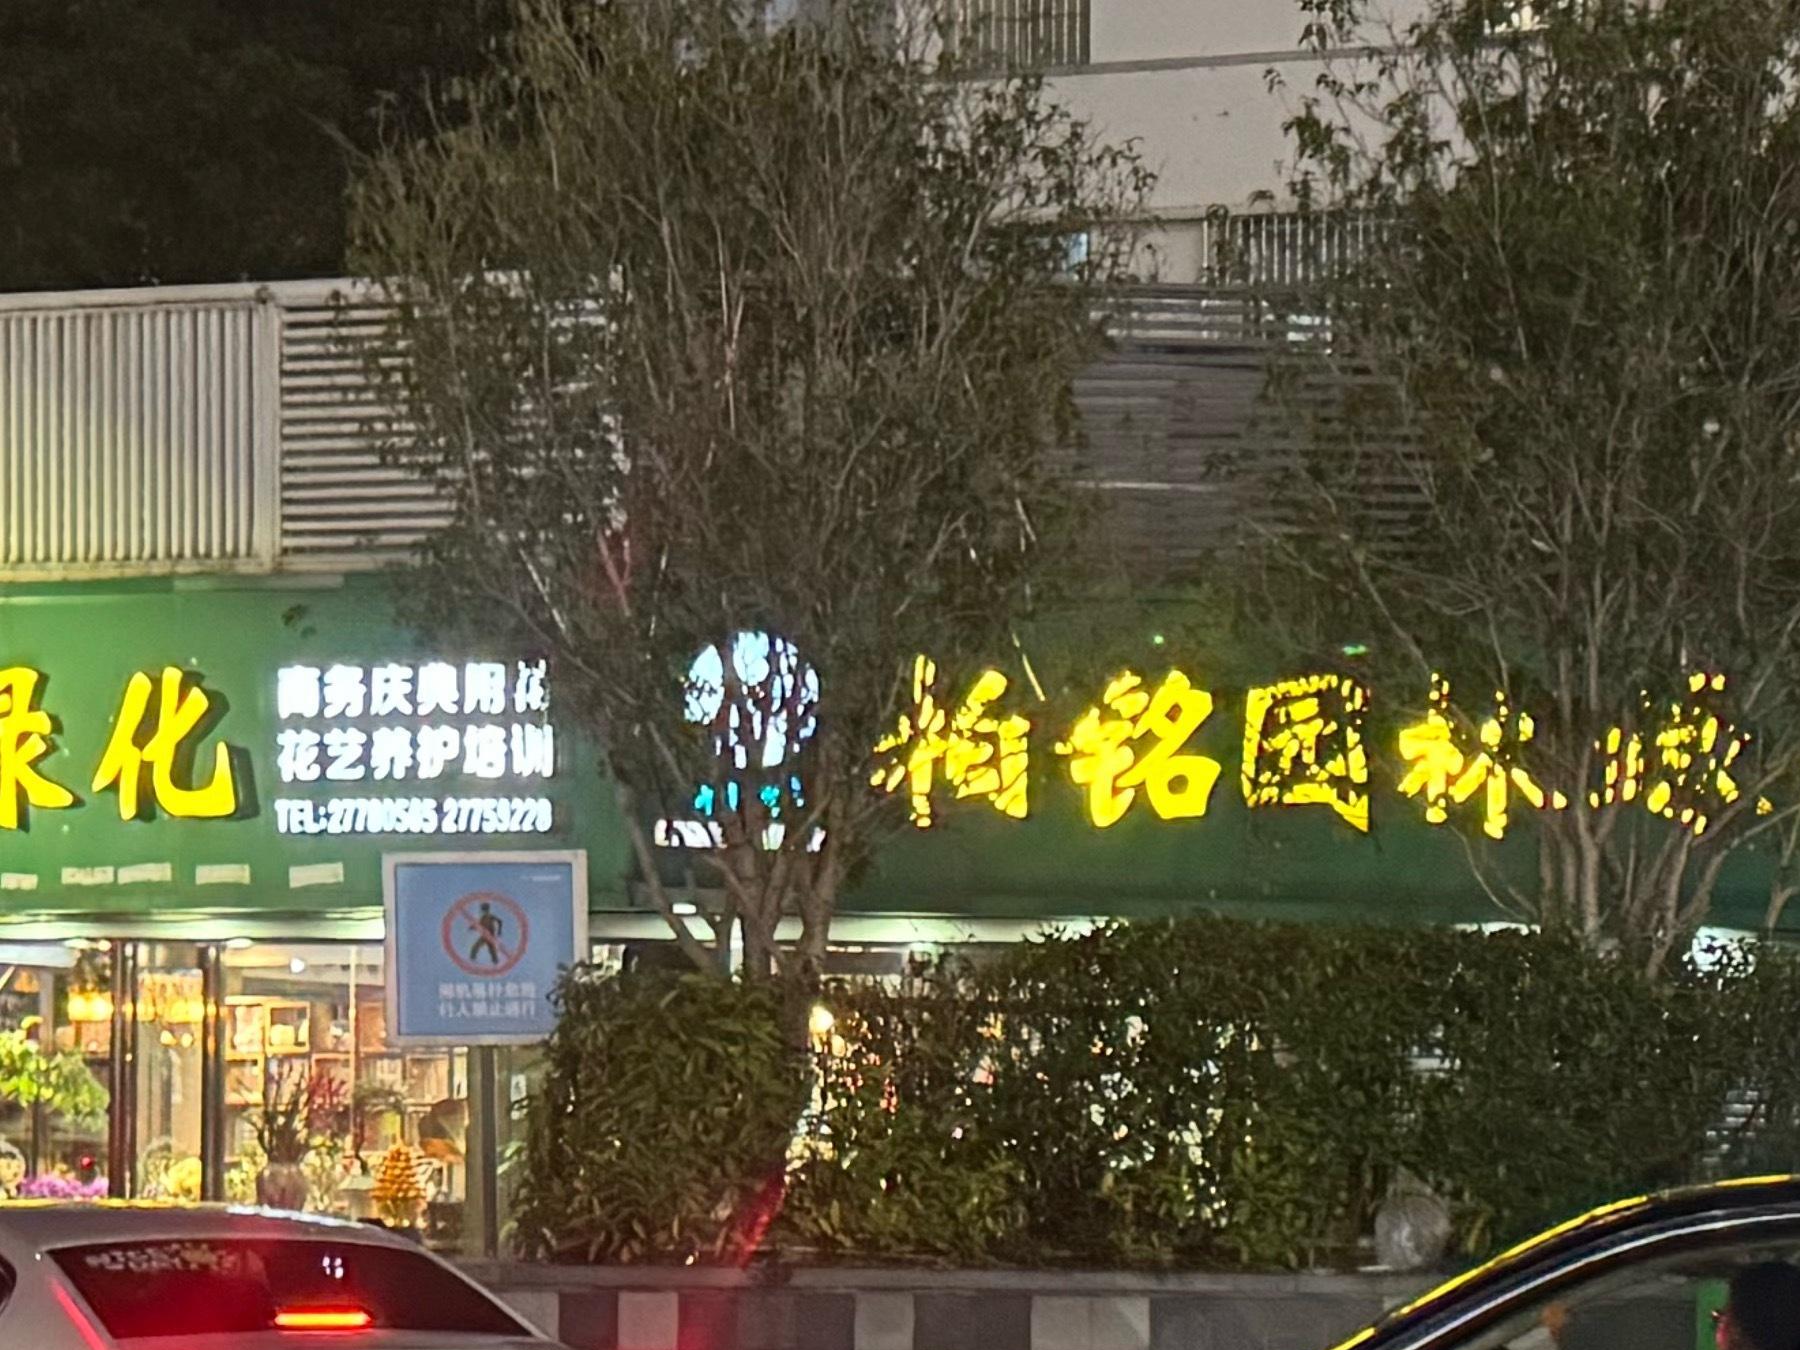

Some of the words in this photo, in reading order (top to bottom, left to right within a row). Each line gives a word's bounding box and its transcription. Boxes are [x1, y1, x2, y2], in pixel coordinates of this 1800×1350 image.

[277, 723, 553, 782] 花艺养护培训
